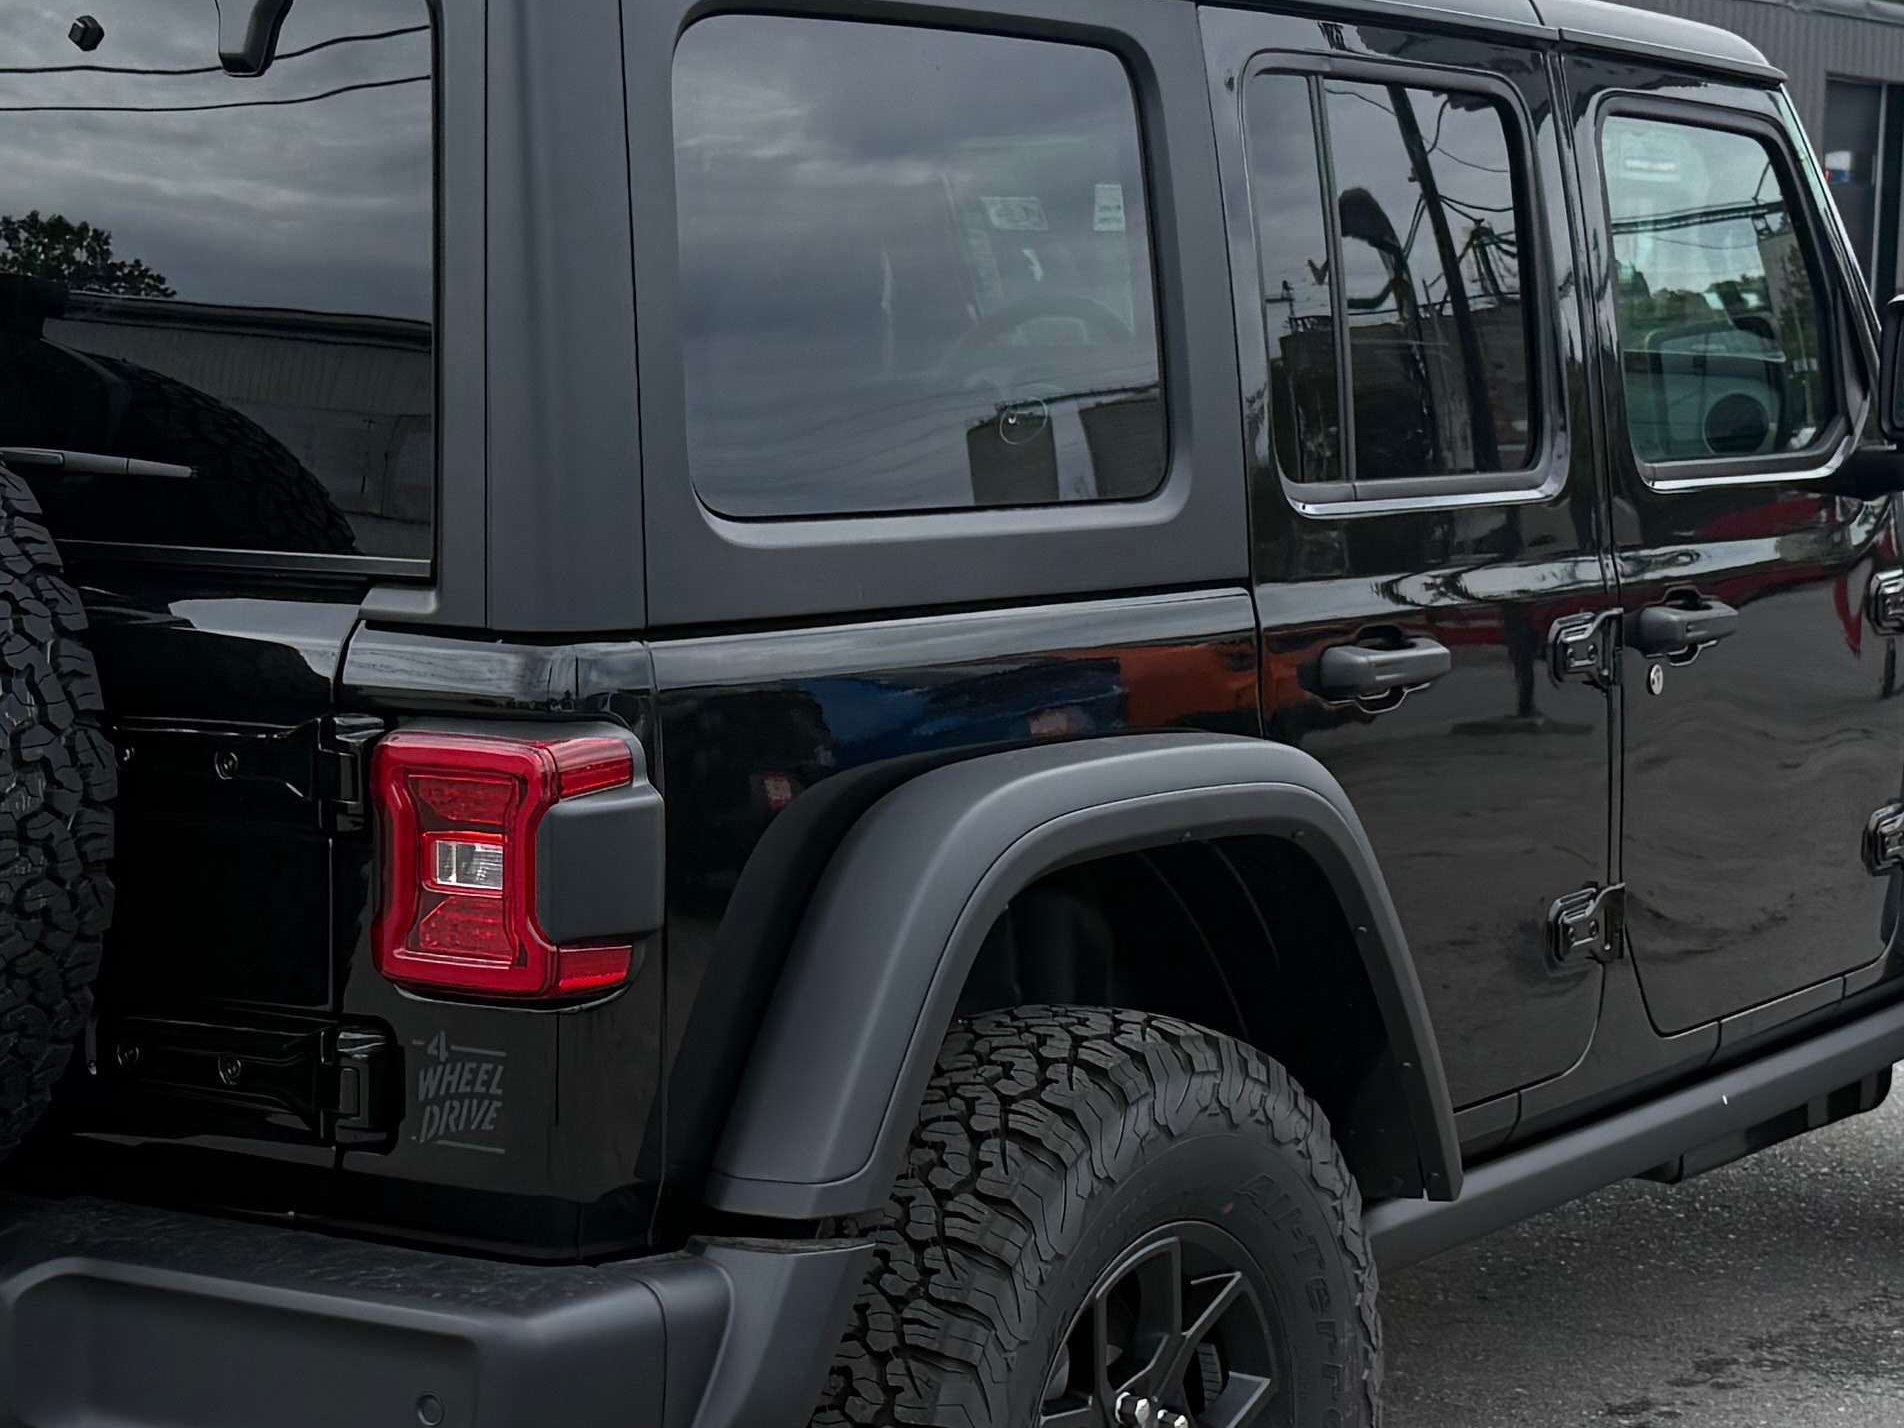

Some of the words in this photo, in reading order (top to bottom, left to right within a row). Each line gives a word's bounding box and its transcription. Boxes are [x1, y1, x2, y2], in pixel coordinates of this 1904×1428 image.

[427, 1030, 448, 1062] 4
[417, 1062, 504, 1101] WHEEL
[419, 1099, 503, 1144] DRIVE
